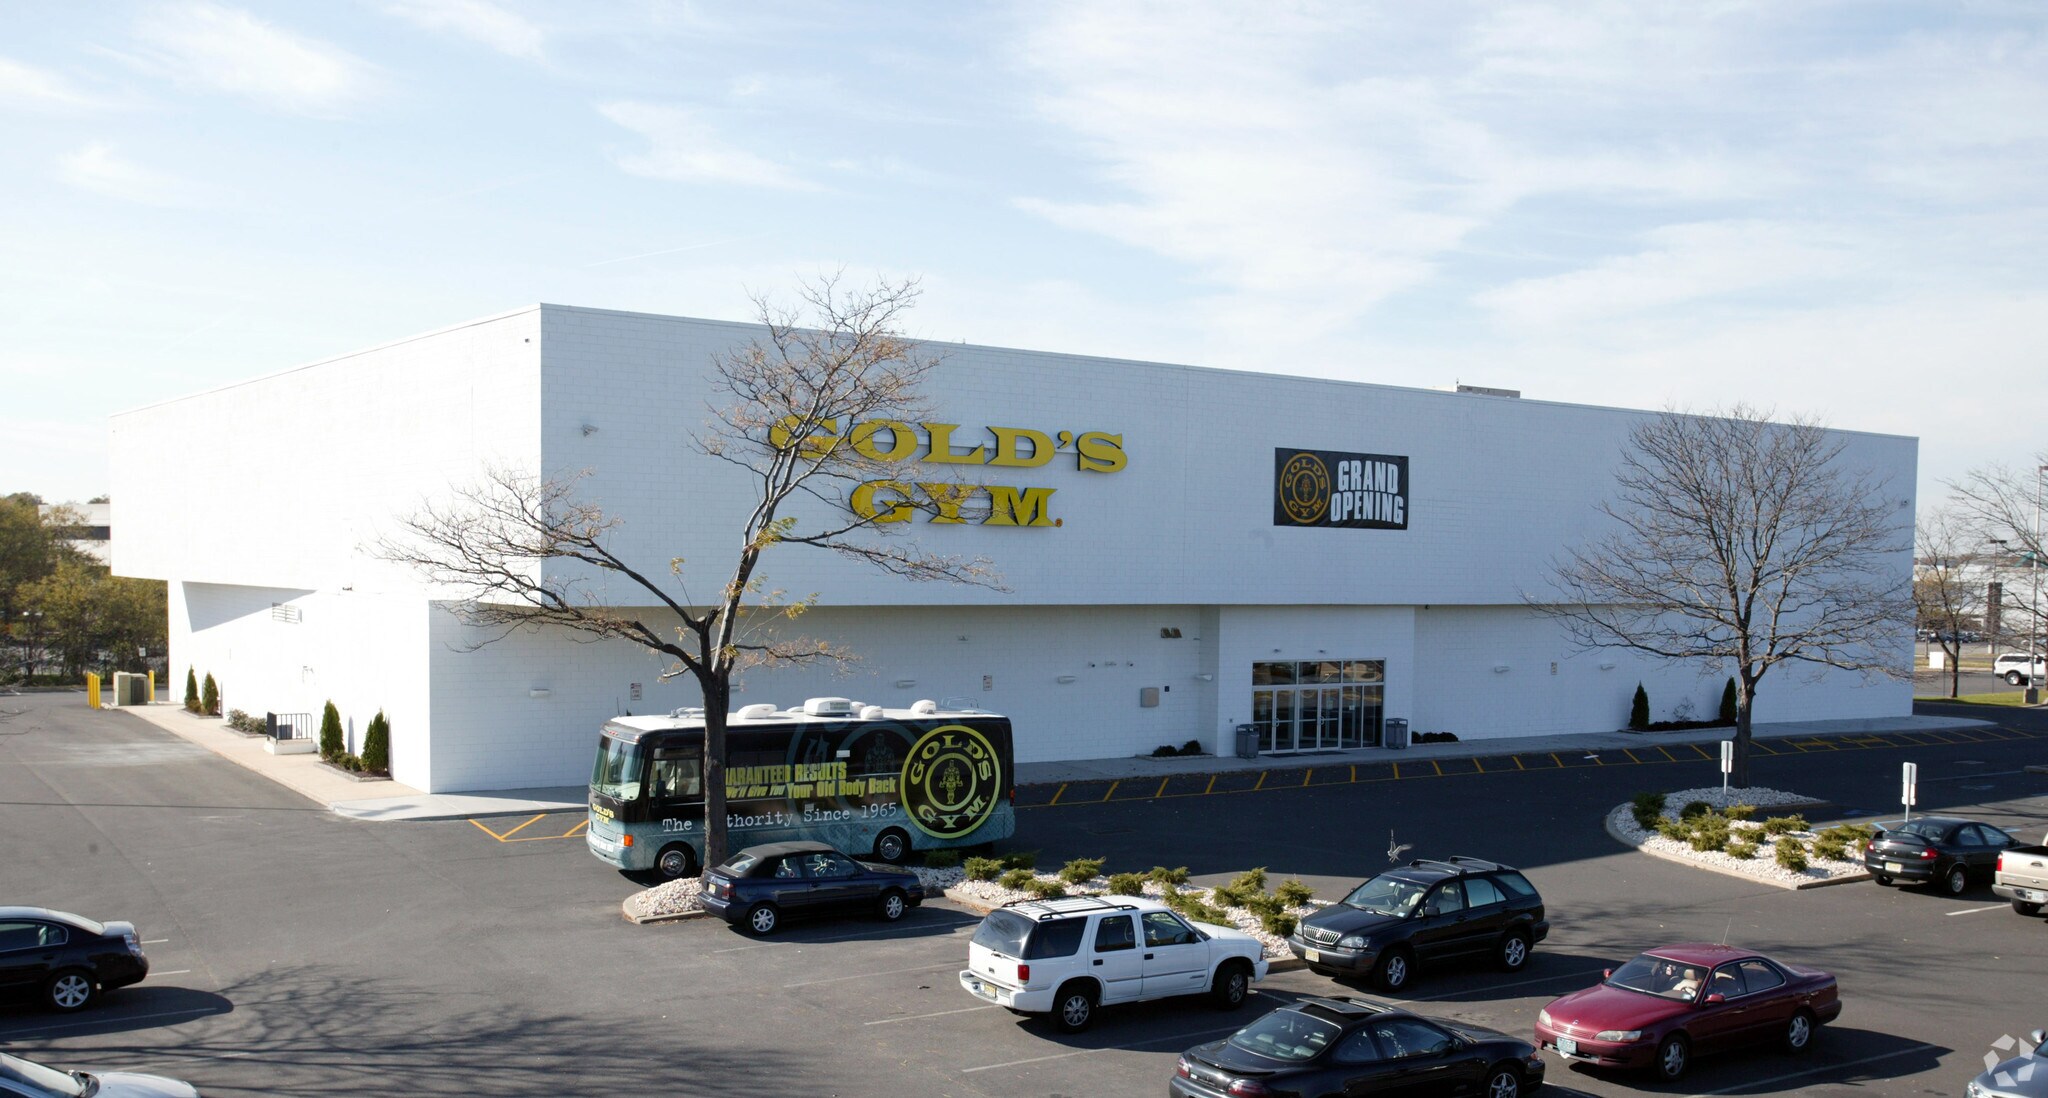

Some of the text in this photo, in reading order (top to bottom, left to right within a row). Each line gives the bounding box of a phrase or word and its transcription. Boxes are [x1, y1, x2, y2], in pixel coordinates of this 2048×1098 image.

[768, 415, 1128, 473] GOLD'S
[1338, 460, 1399, 495] GRAND
[1330, 491, 1404, 525] OPENING
[726, 762, 848, 786] ARANTEED RESULTS
[911, 735, 992, 785] GOLD'S
[786, 782, 814, 799] Your
[816, 781, 836, 797] Old
[838, 779, 867, 798] Body
[868, 777, 897, 795] Back
[662, 802, 897, 832] The thority Since 1965
